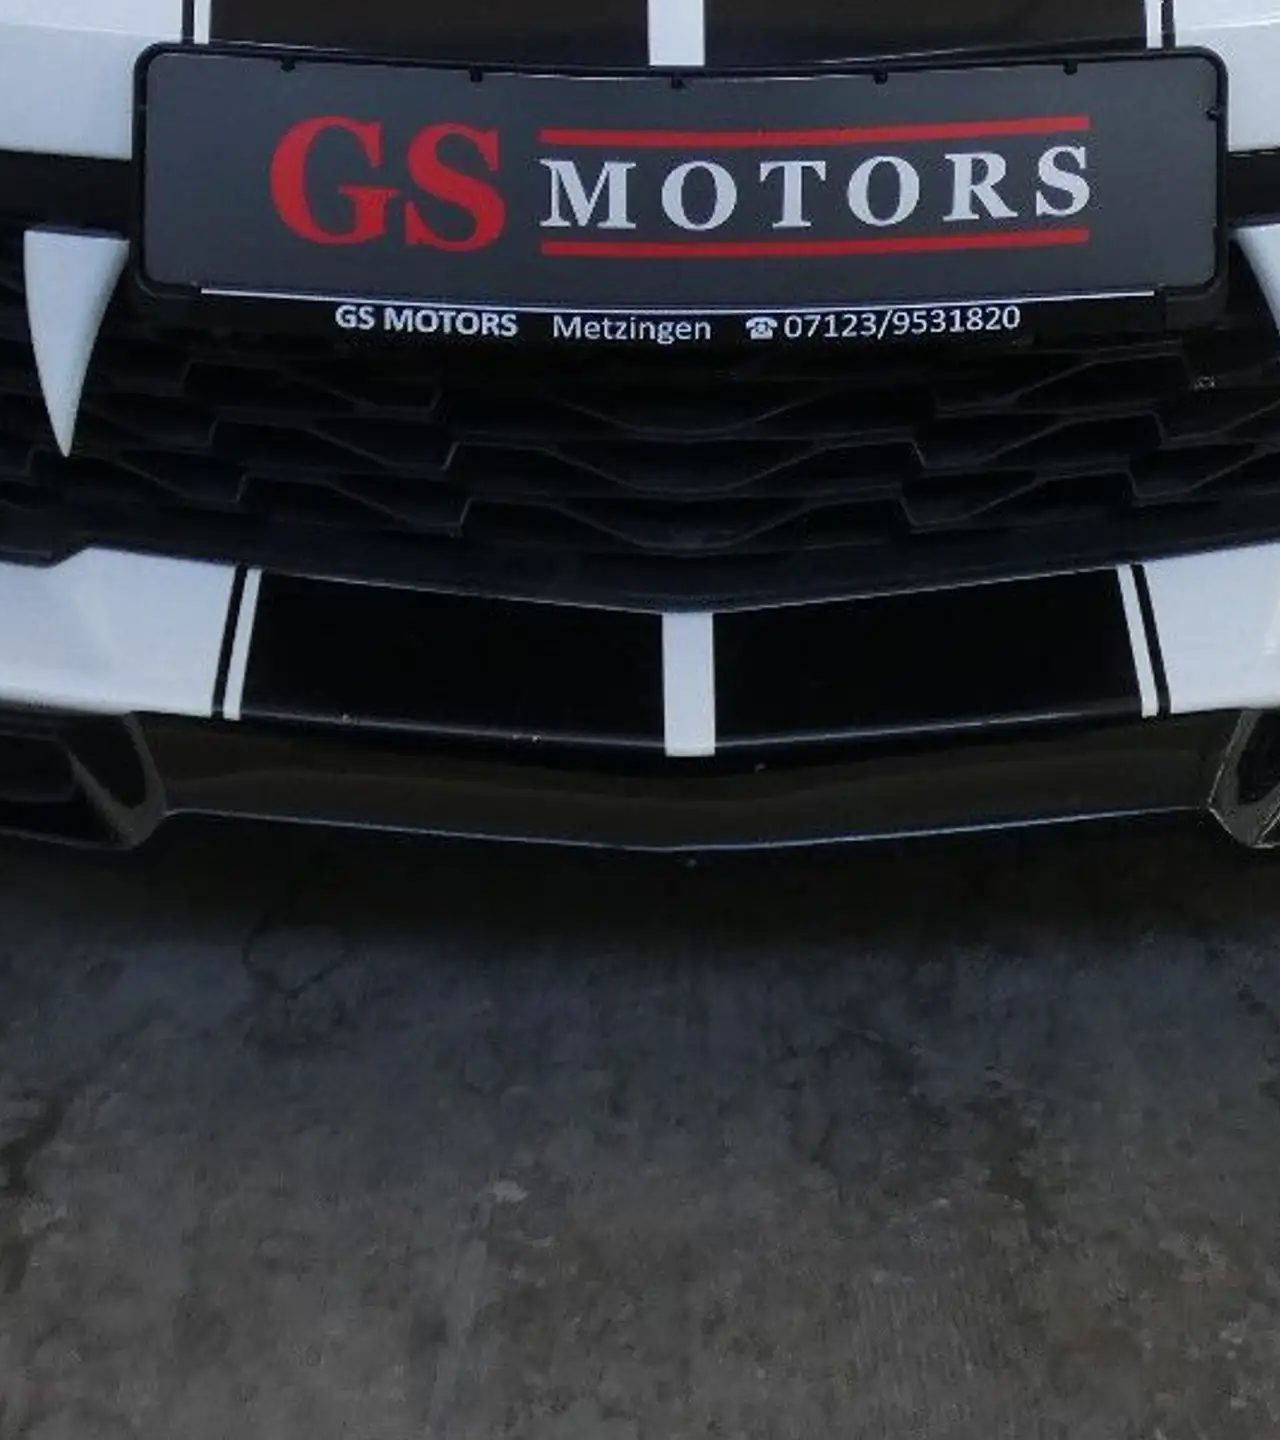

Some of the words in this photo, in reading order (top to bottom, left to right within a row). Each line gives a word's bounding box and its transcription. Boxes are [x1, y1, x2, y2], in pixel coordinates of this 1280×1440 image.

[270, 115, 506, 252] GS
[540, 145, 1091, 231] MOTORS
[335, 303, 378, 332] GS
[384, 304, 519, 338] MOTORS
[553, 313, 712, 345] Metzingen
[783, 304, 1021, 339] 07123/9531820
